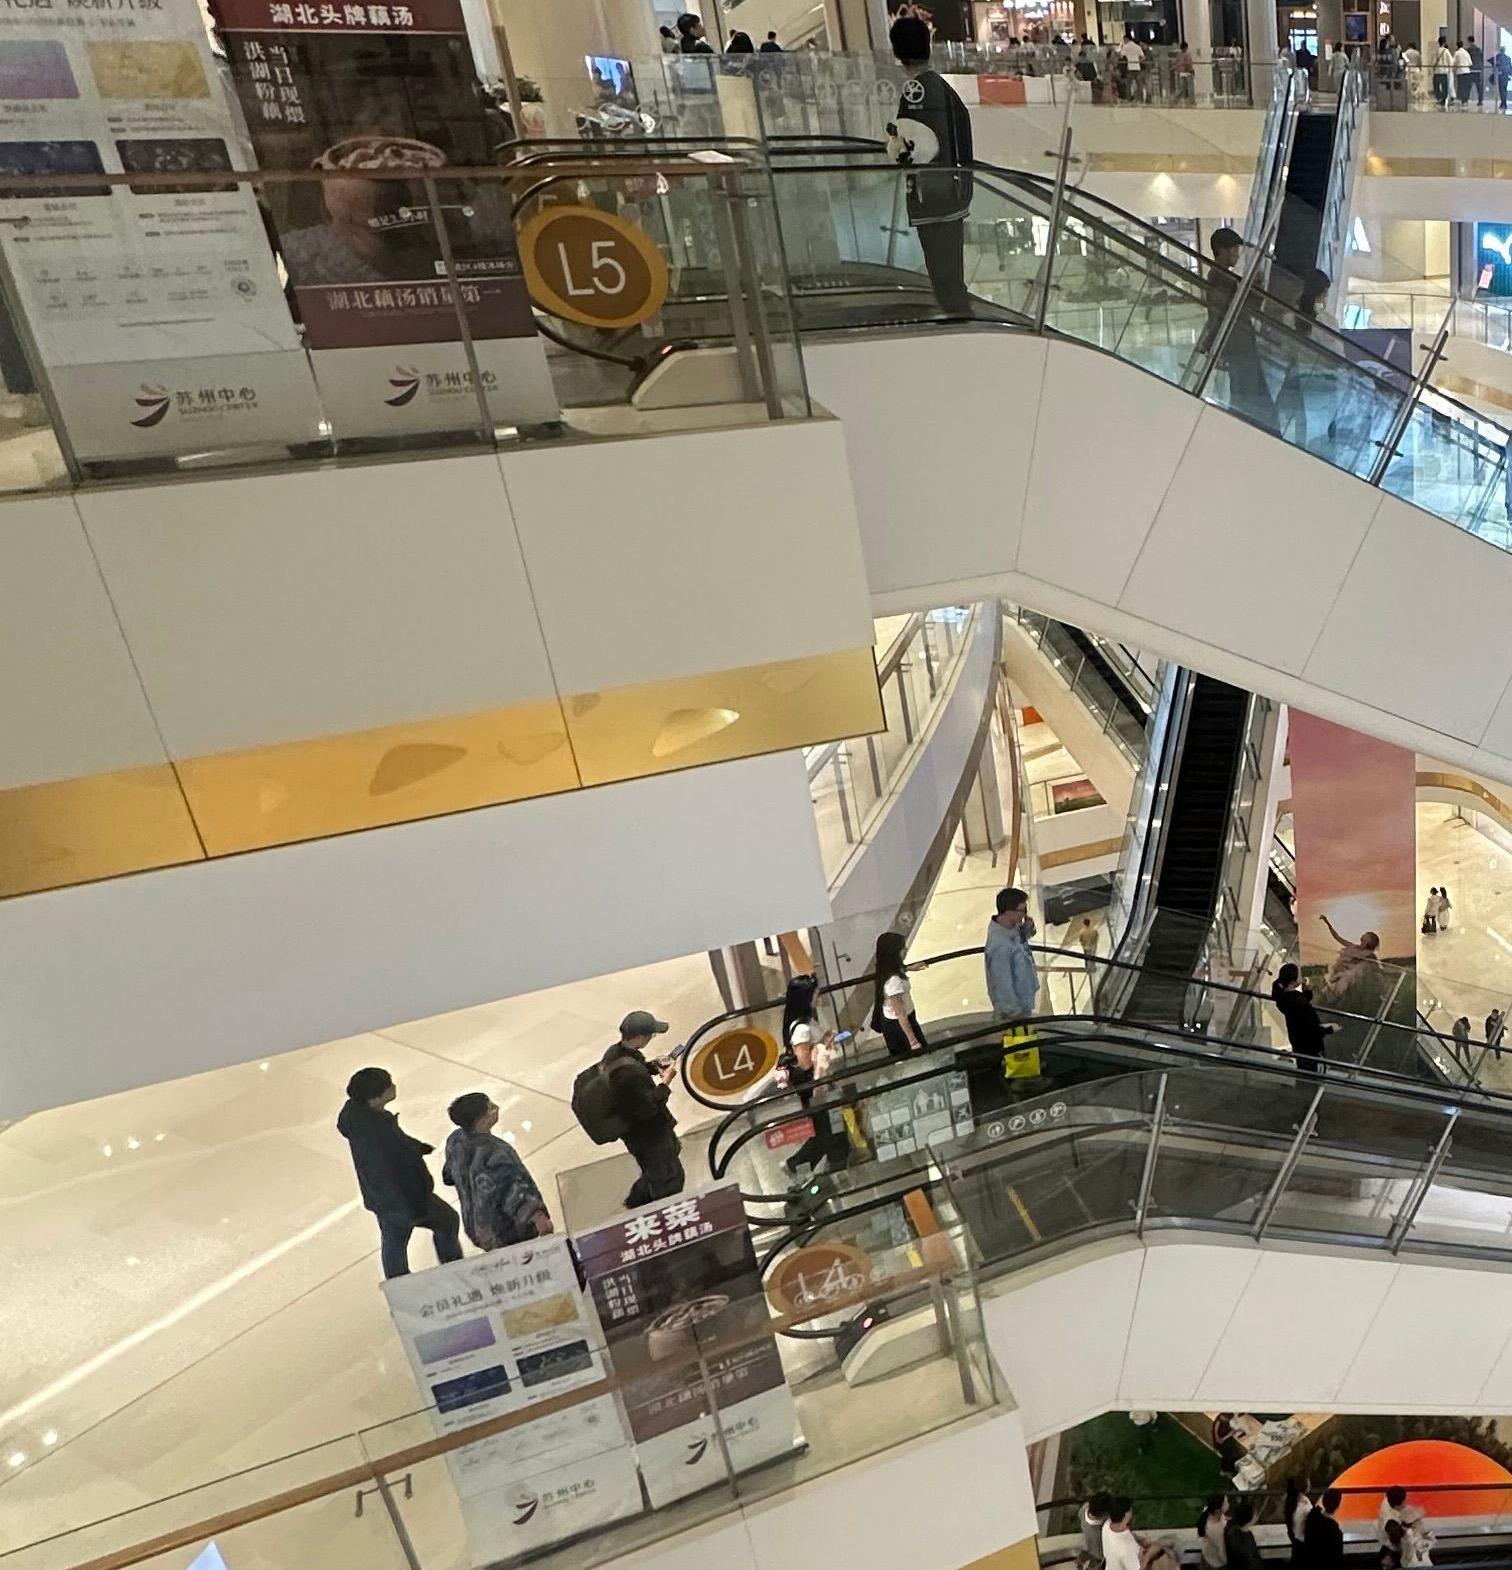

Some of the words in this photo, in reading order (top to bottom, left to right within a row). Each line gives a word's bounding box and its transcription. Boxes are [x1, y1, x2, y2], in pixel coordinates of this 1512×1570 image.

[558, 241, 626, 296] L5
[175, 385, 257, 406] 苏州中心
[713, 1044, 755, 1080] L4
[624, 1199, 700, 1244] 来菜
[797, 1257, 848, 1302] L4
